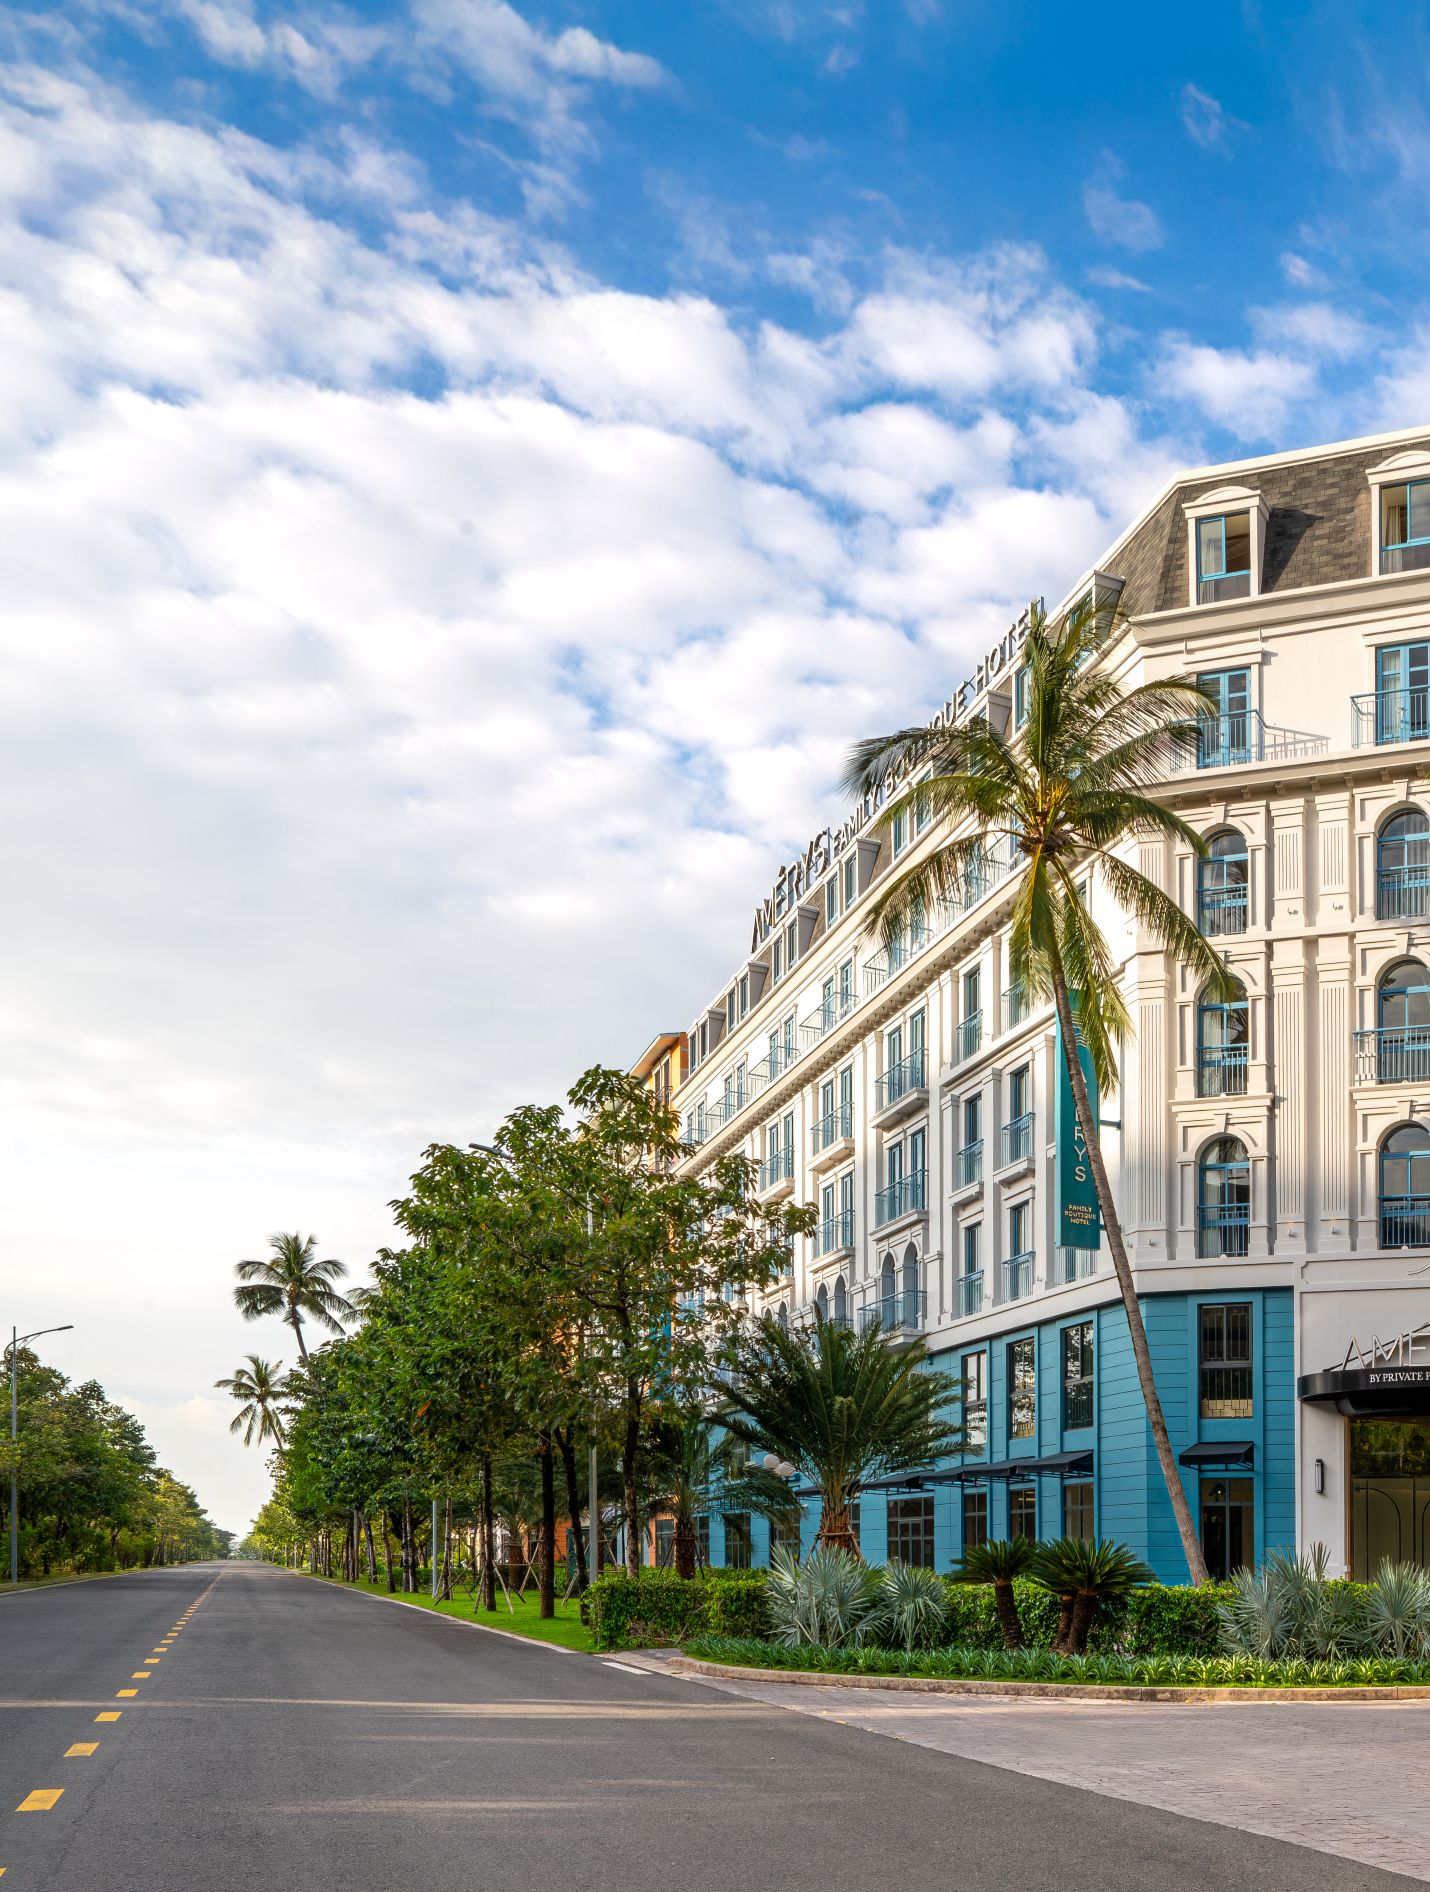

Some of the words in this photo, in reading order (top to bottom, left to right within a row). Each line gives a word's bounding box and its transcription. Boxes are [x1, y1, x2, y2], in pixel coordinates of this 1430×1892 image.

[751, 828, 829, 953] AMÉRYS
[833, 783, 879, 859] FAMILY
[885, 680, 968, 798] BOQUE
[1068, 1204, 1092, 1213] FAMILY
[1064, 1210, 1097, 1220] BOUTIQUE
[1070, 1218, 1091, 1226] HOTEL
[1369, 1373, 1381, 1383] BY
[1382, 1371, 1424, 1383] PRIVATE
